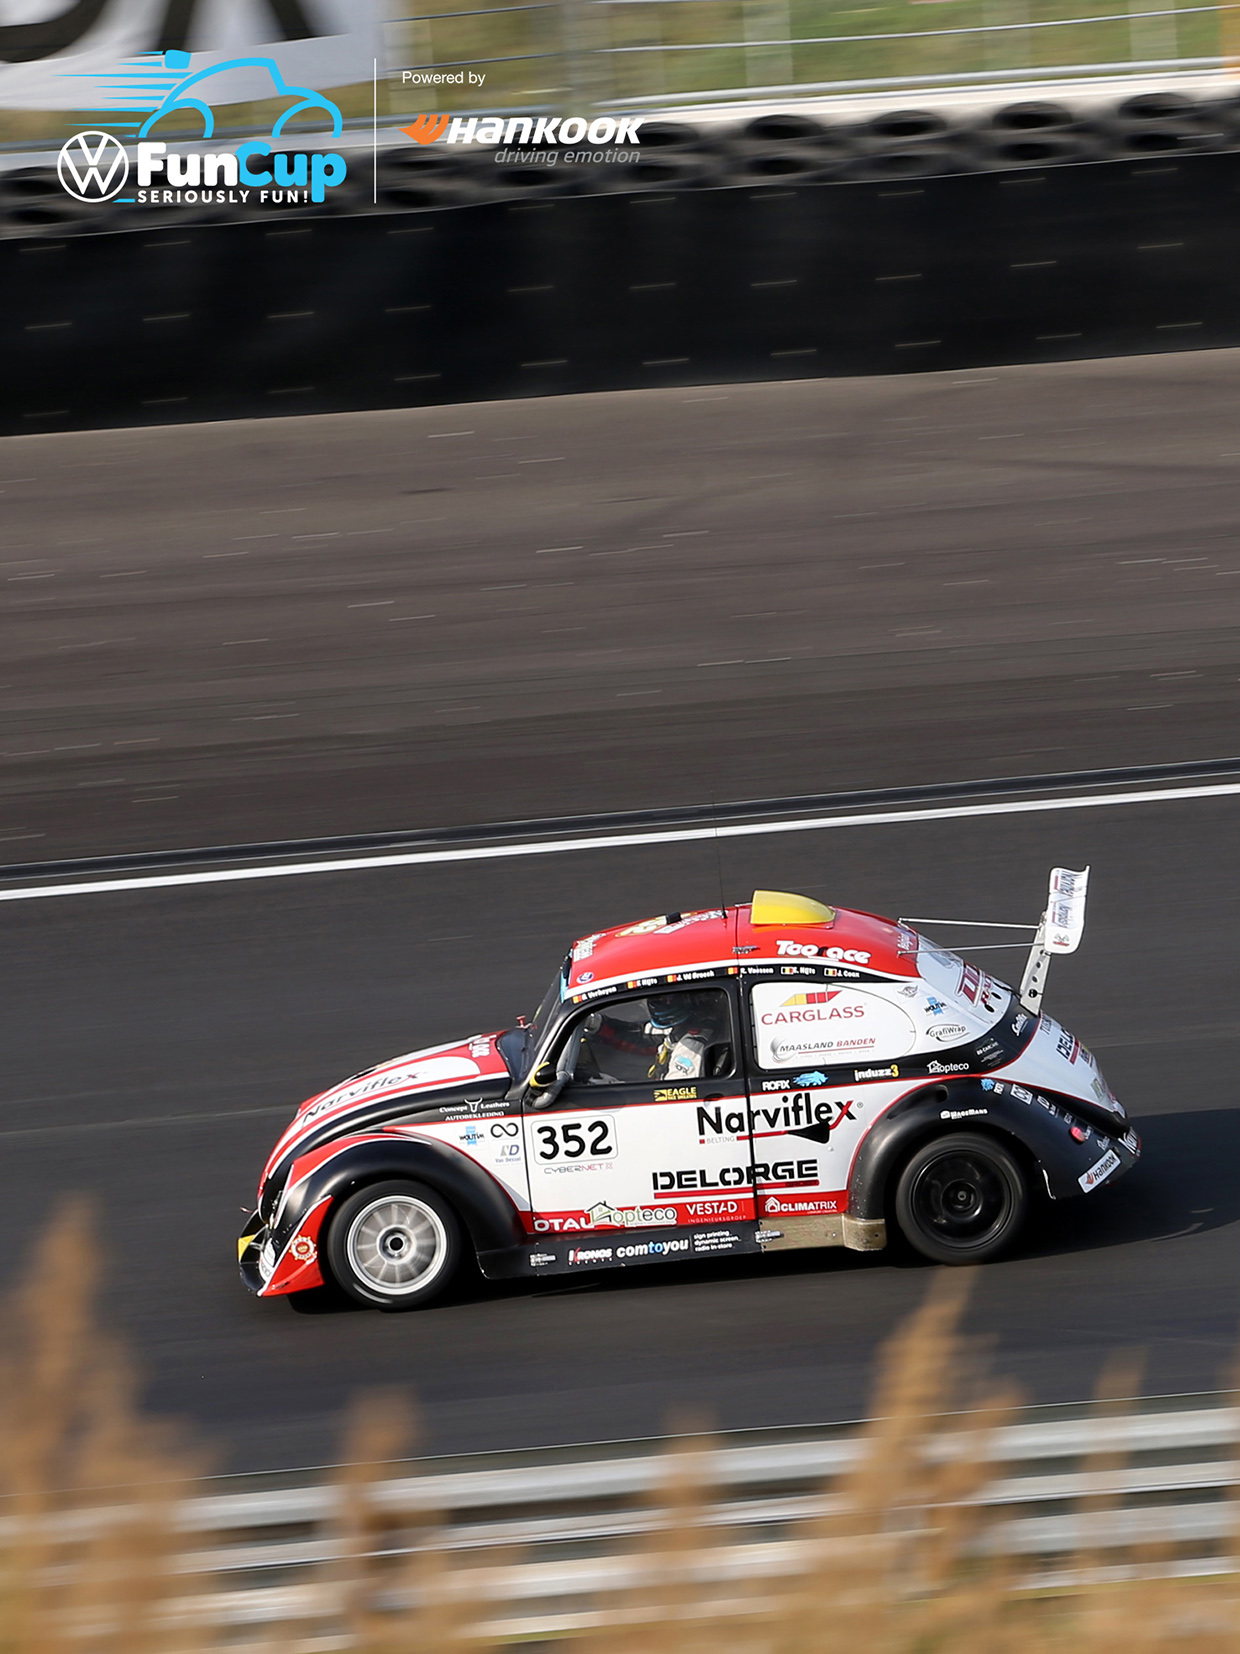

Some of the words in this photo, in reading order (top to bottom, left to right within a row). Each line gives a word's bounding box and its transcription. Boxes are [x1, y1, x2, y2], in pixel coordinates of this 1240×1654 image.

[761, 1005, 865, 1026] CARGLASS
[929, 1024, 967, 1038] GrafiWrap
[779, 1041, 834, 1052] MAASLAND
[836, 1037, 877, 1047] BANDEN
[667, 1086, 698, 1097] EAGLE
[762, 1079, 791, 1091] ROFIX
[303, 1071, 422, 1123] Narviflex
[439, 1105, 468, 1114] Concept
[481, 1101, 510, 1109] Leathers
[696, 1092, 857, 1136] Narviflex
[445, 1110, 505, 1121] AUTOBEKLEDING
[536, 1120, 613, 1160] 352
[706, 1135, 736, 1144] BELTING
[652, 1159, 819, 1190] DELORGE
[780, 1200, 838, 1212] CLIMATRIX
[533, 1216, 596, 1232] OTAL
[687, 1214, 747, 1224] INGENIEURSGROEP
[569, 1247, 613, 1262] KRONOS
[616, 1239, 689, 1258] comtoyou
